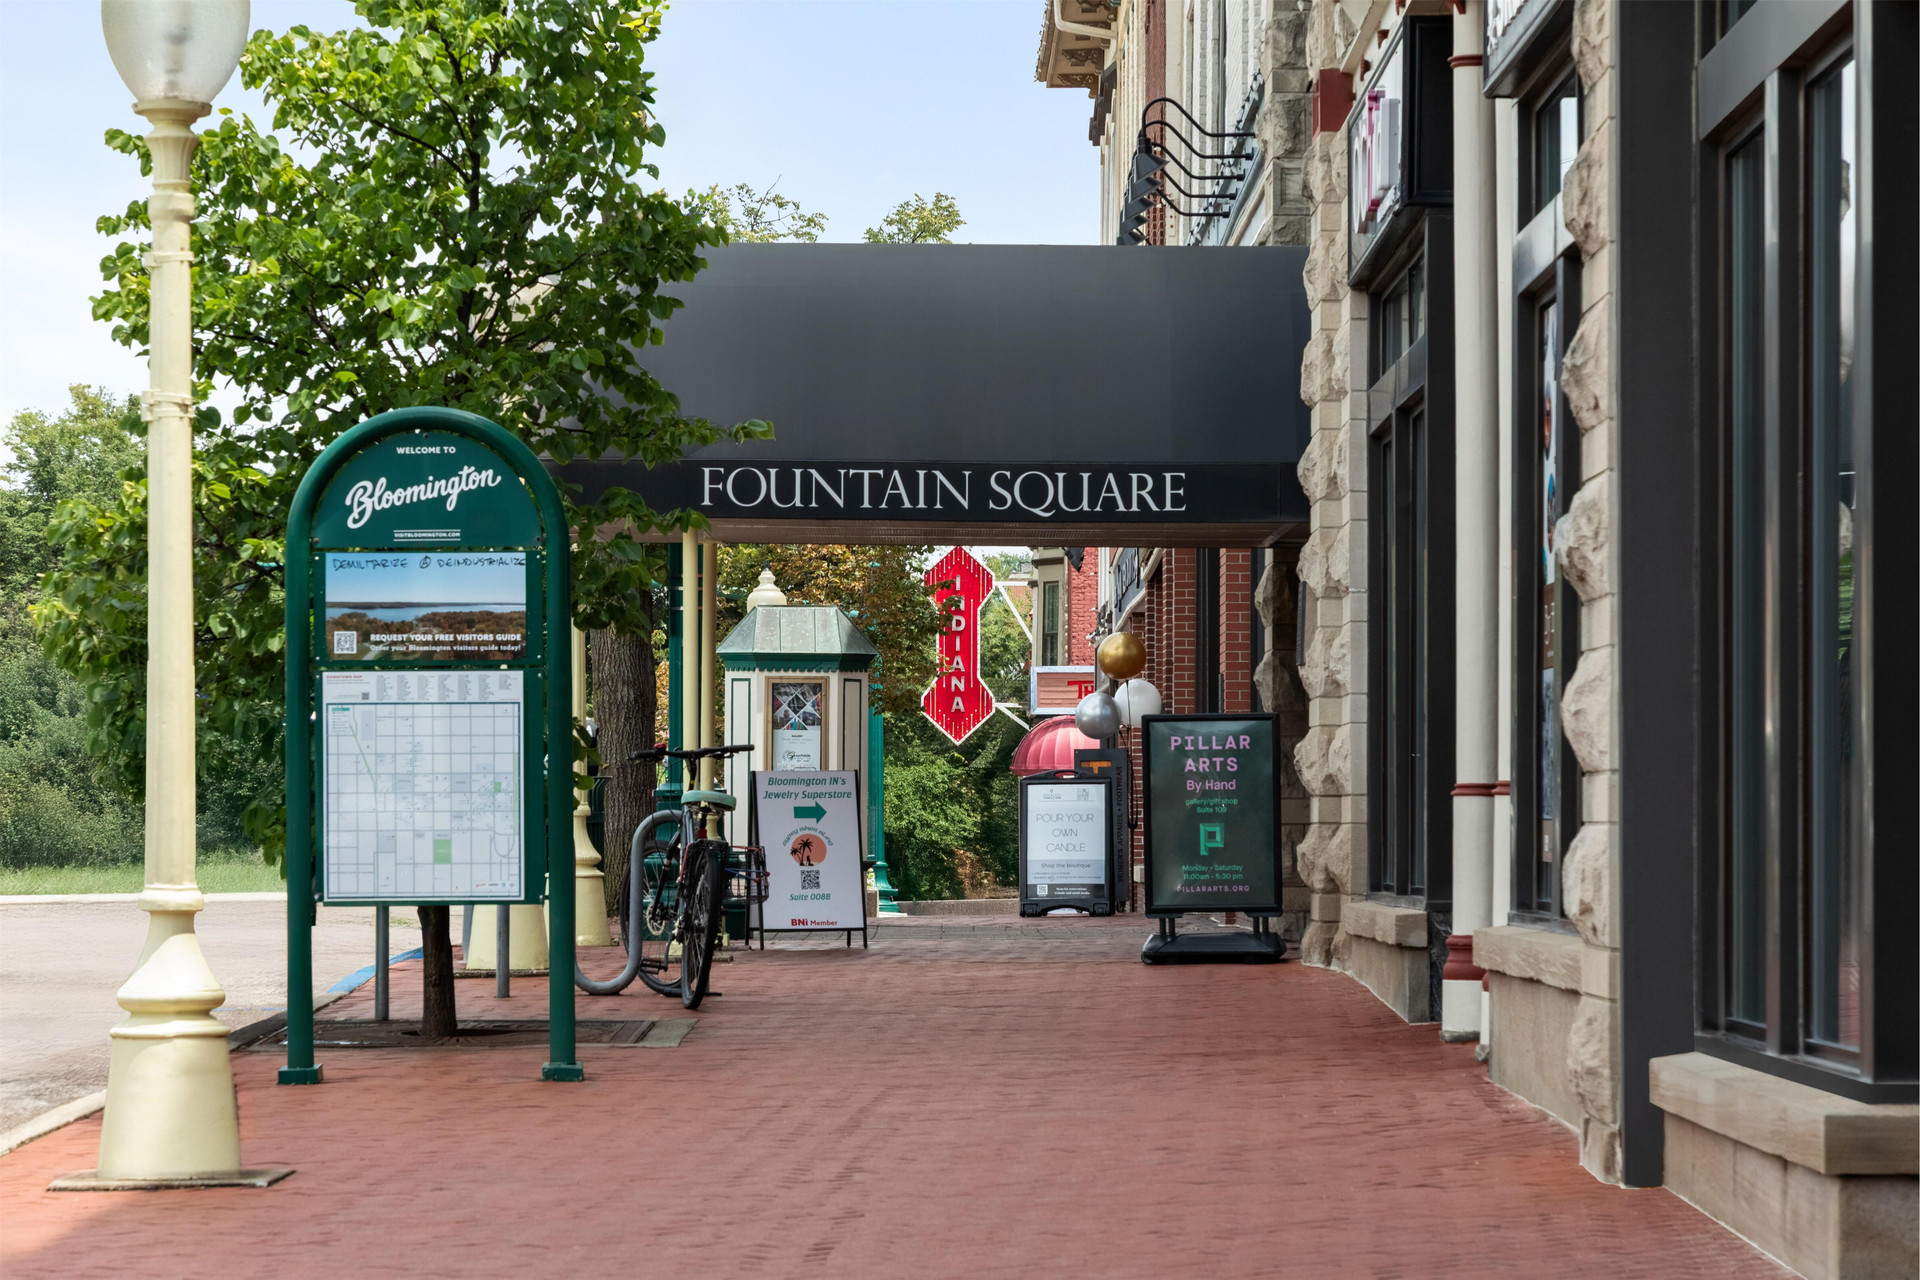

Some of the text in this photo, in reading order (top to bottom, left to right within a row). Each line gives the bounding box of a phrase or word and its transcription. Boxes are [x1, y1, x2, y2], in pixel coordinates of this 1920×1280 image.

[396, 446, 456, 454] WELCOME TO
[345, 465, 502, 529] Bloomington
[701, 467, 1187, 517] FOUNTAIN SQUARE
[332, 558, 408, 571] DEMILITARIZE
[370, 633, 522, 642] REQUEST YOUR FREE VISITORS GUIDE
[408, 644, 451, 652] Bloomington
[480, 644, 499, 652] guide
[500, 644, 521, 652] today!
[1170, 735, 1251, 751] PILLAR
[1184, 757, 1238, 773] ARTS
[768, 777, 846, 787] Bloomington IN's
[1186, 779, 1236, 793] By Hand
[763, 790, 852, 800] Jewelry Superstore
[1036, 813, 1095, 822] POUR YOUR
[1052, 828, 1078, 838] OWN
[1046, 843, 1086, 852] CANDLE
[1214, 864, 1243, 872] Saturday
[1176, 885, 1250, 893] PILLARARTS.ORG
